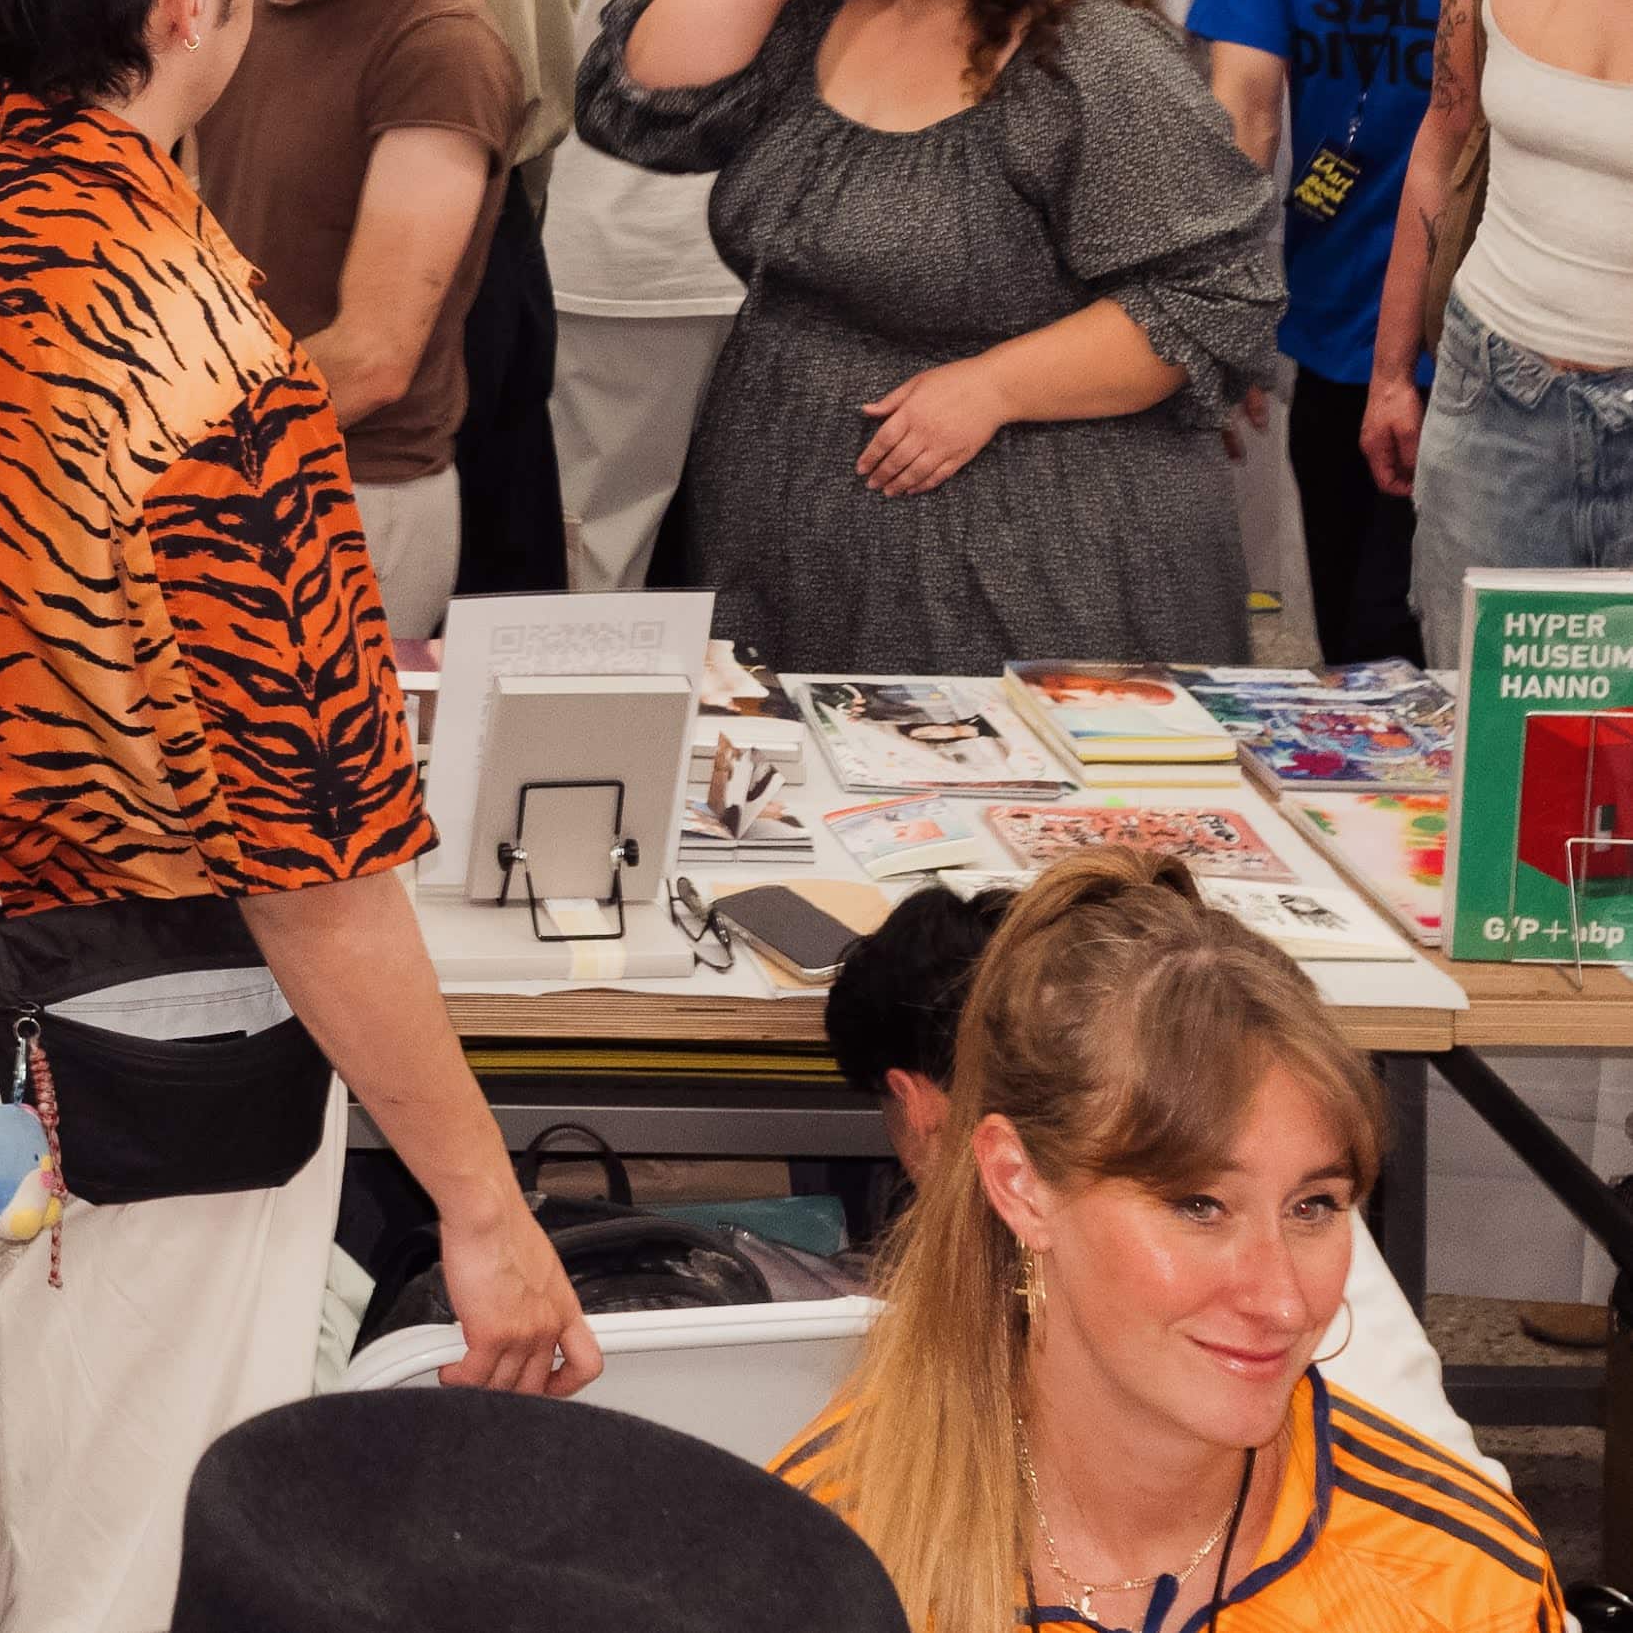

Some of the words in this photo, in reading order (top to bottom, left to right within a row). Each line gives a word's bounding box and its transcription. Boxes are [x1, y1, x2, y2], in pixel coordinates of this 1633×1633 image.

[1504, 612, 1607, 638] HYPER
[1503, 643, 1633, 669] MUSEUM
[1501, 674, 1610, 700] HANNO
